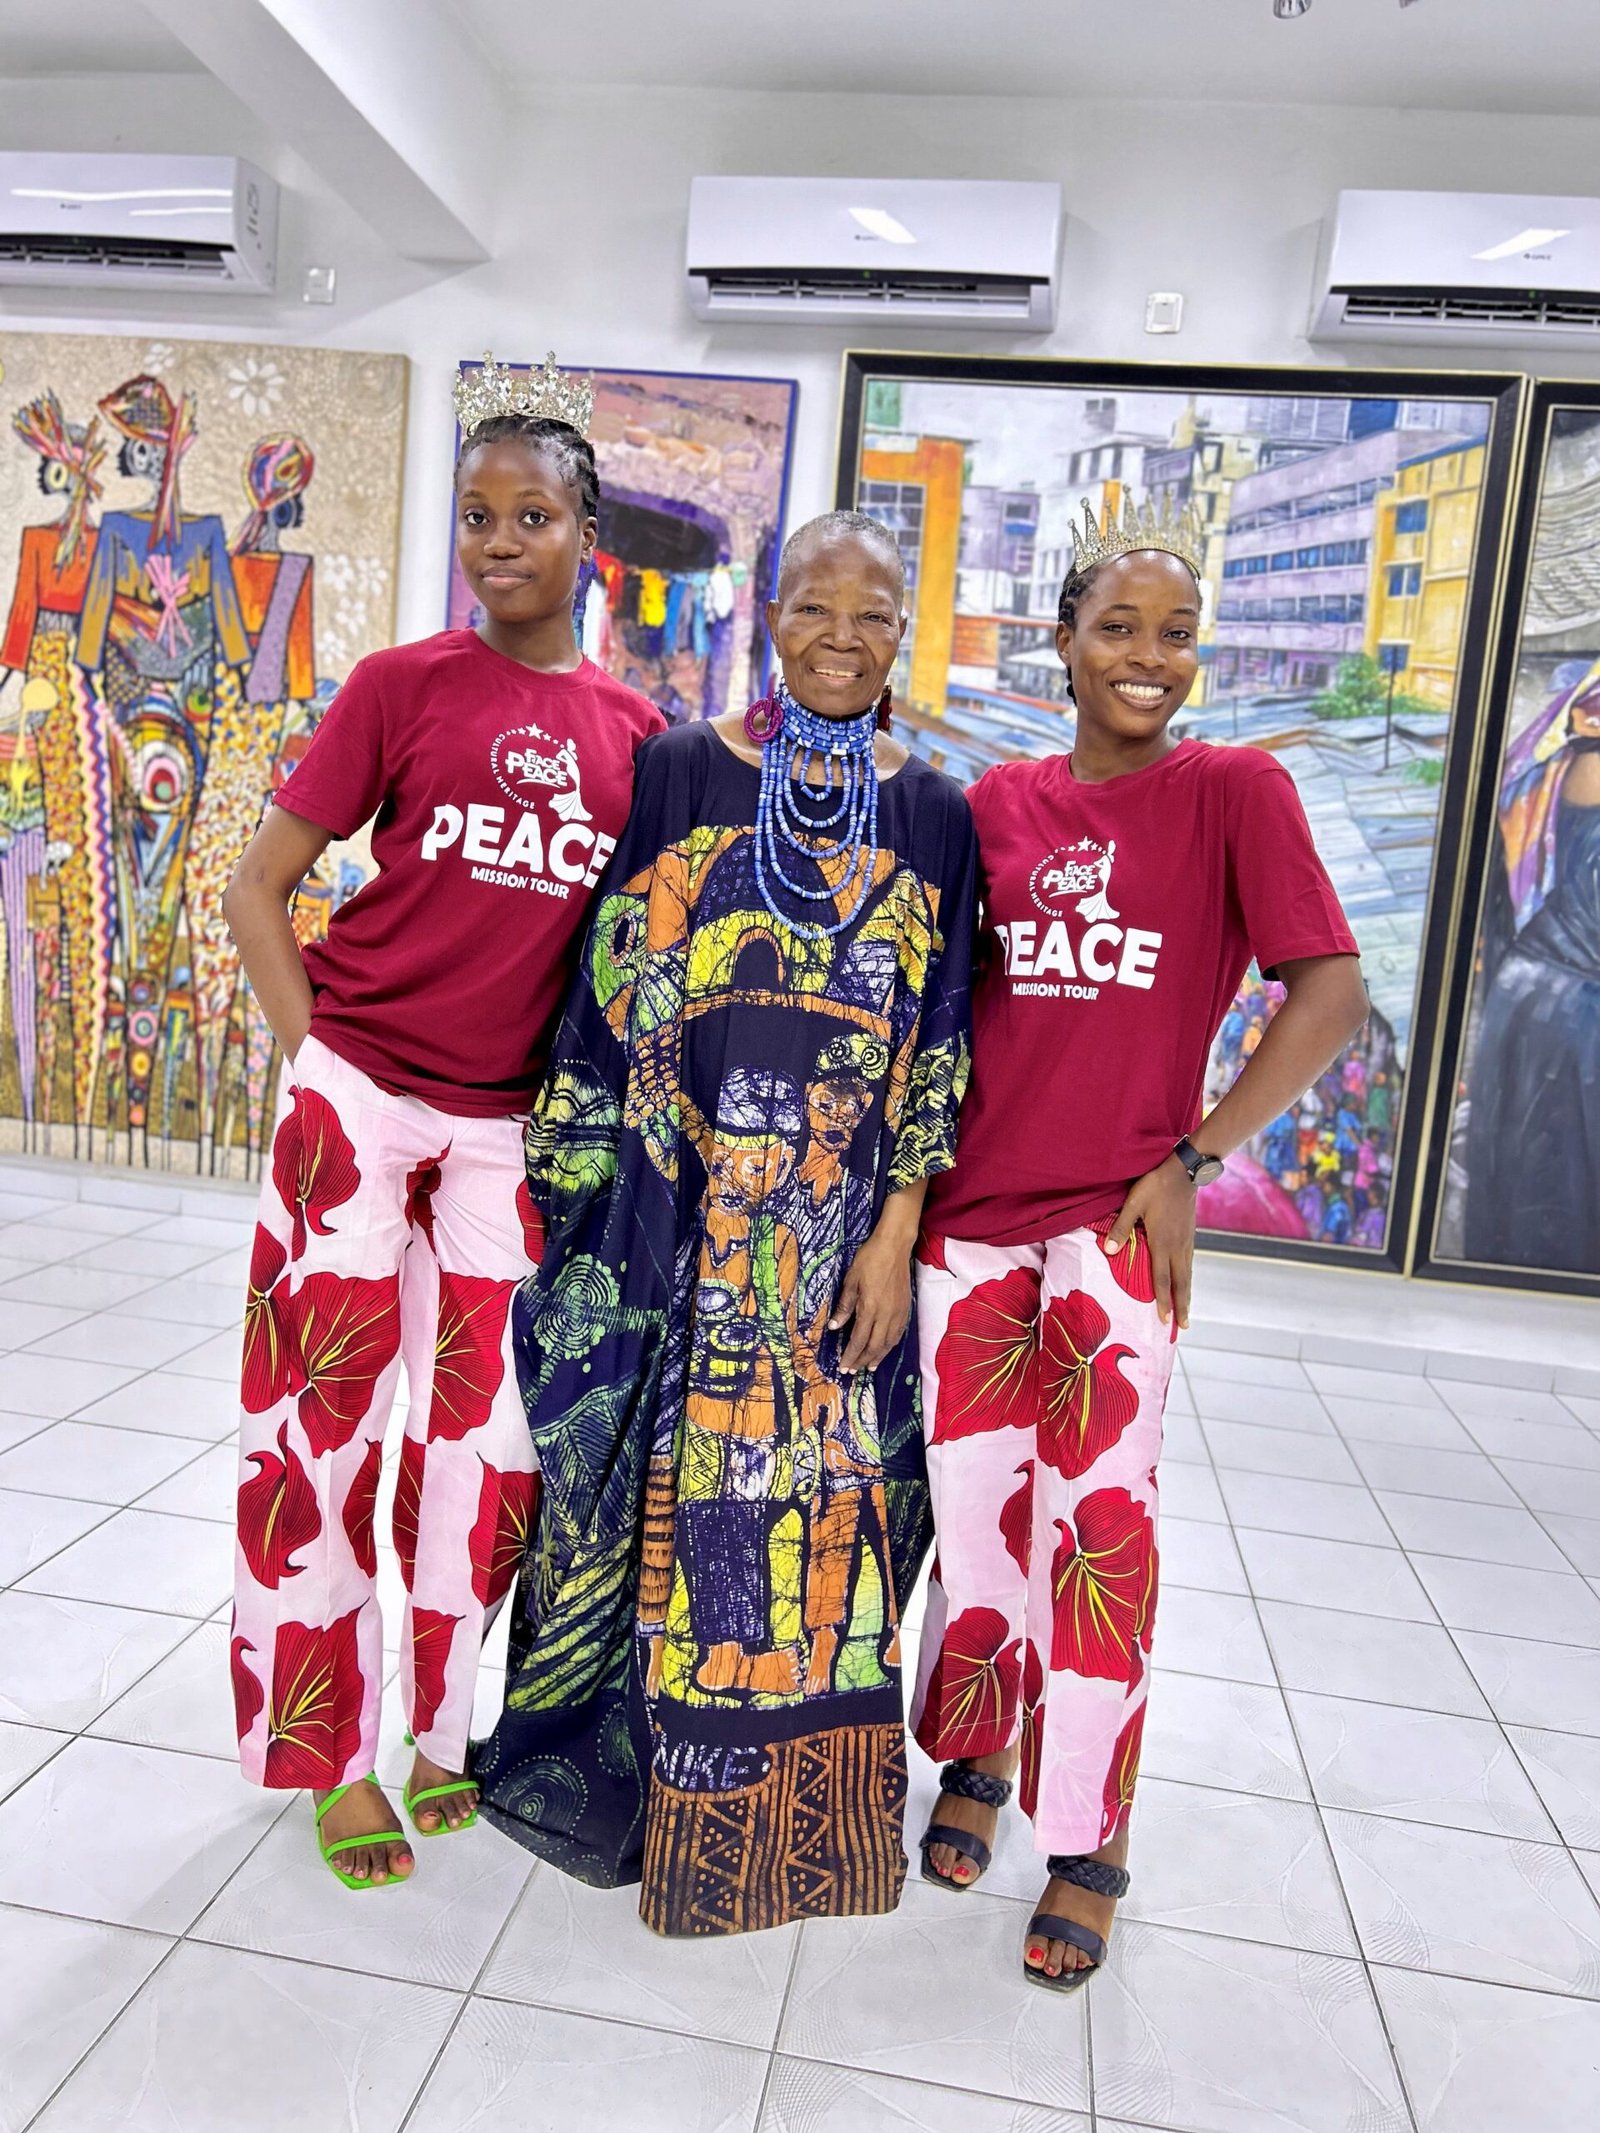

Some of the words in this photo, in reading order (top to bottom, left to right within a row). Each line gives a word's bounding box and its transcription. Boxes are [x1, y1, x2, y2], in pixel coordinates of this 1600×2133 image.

[490, 733, 505, 775] CULTURAL
[505, 750, 568, 787] PEACE
[524, 748, 560, 771] FACE
[496, 776, 535, 809] HERITAGE
[420, 803, 617, 889] PEACE
[471, 866, 529, 889] MISSION
[529, 877, 570, 900] TOUR
[1029, 854, 1055, 892] CULTURAL
[1042, 869, 1098, 891] PEACE
[1031, 893, 1063, 918] HERITAGE
[1012, 982, 1060, 998] MISSION
[1063, 984, 1100, 1001] TOUR
